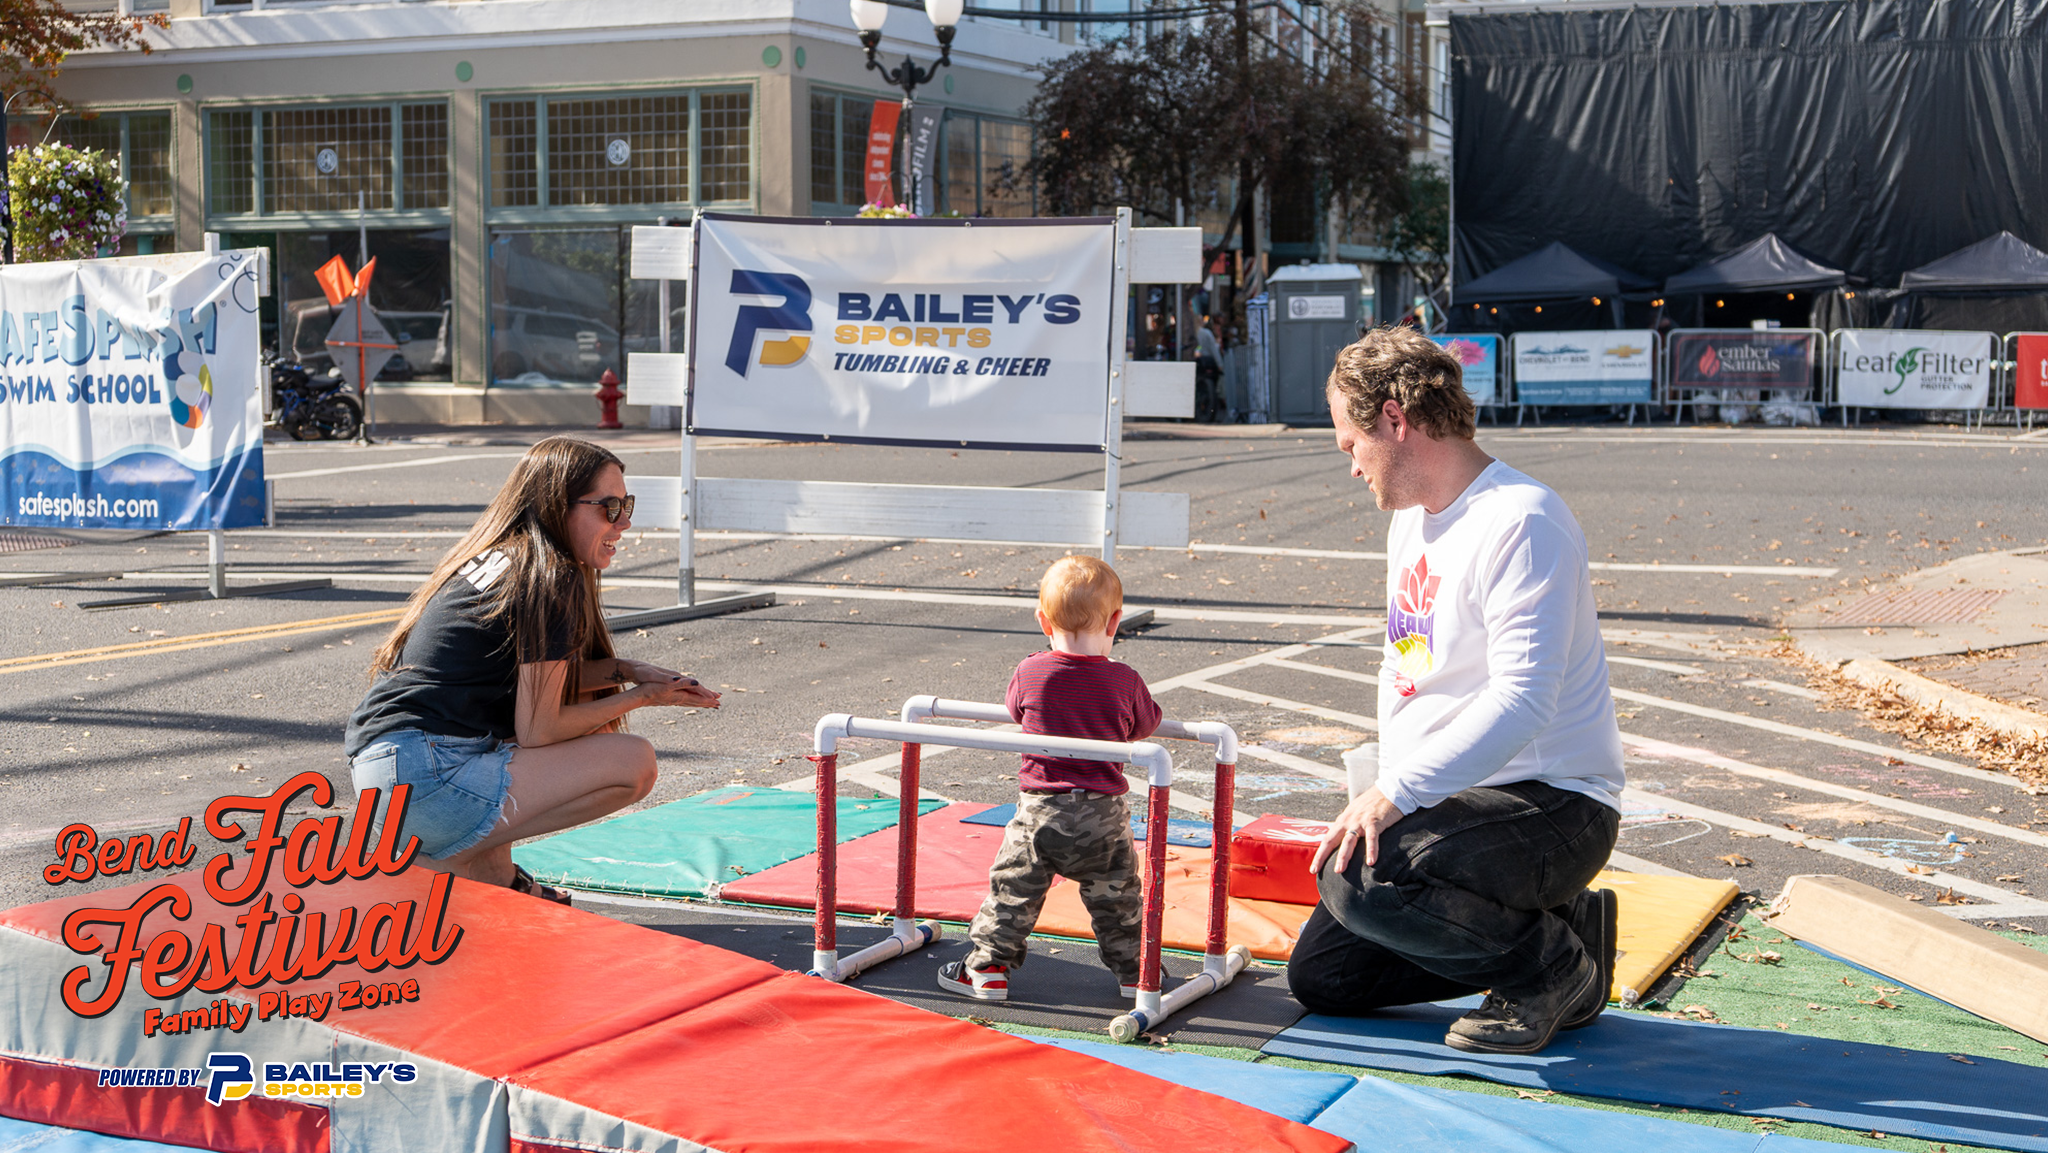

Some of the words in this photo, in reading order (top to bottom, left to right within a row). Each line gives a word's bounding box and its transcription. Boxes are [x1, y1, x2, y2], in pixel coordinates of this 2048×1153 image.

[837, 292, 1082, 325] BAILEY'S
[834, 324, 992, 348] SPORTS
[1718, 344, 1772, 359] ember
[1921, 352, 1985, 375] Filter
[834, 353, 951, 375] TUMBLING
[953, 359, 970, 375] &
[976, 357, 1052, 377] CHEER
[1722, 358, 1781, 372] saunas
[66, 374, 161, 404] SCHOOL
[1920, 383, 1973, 391] PROTECTION
[19, 492, 159, 522] safesplash.com
